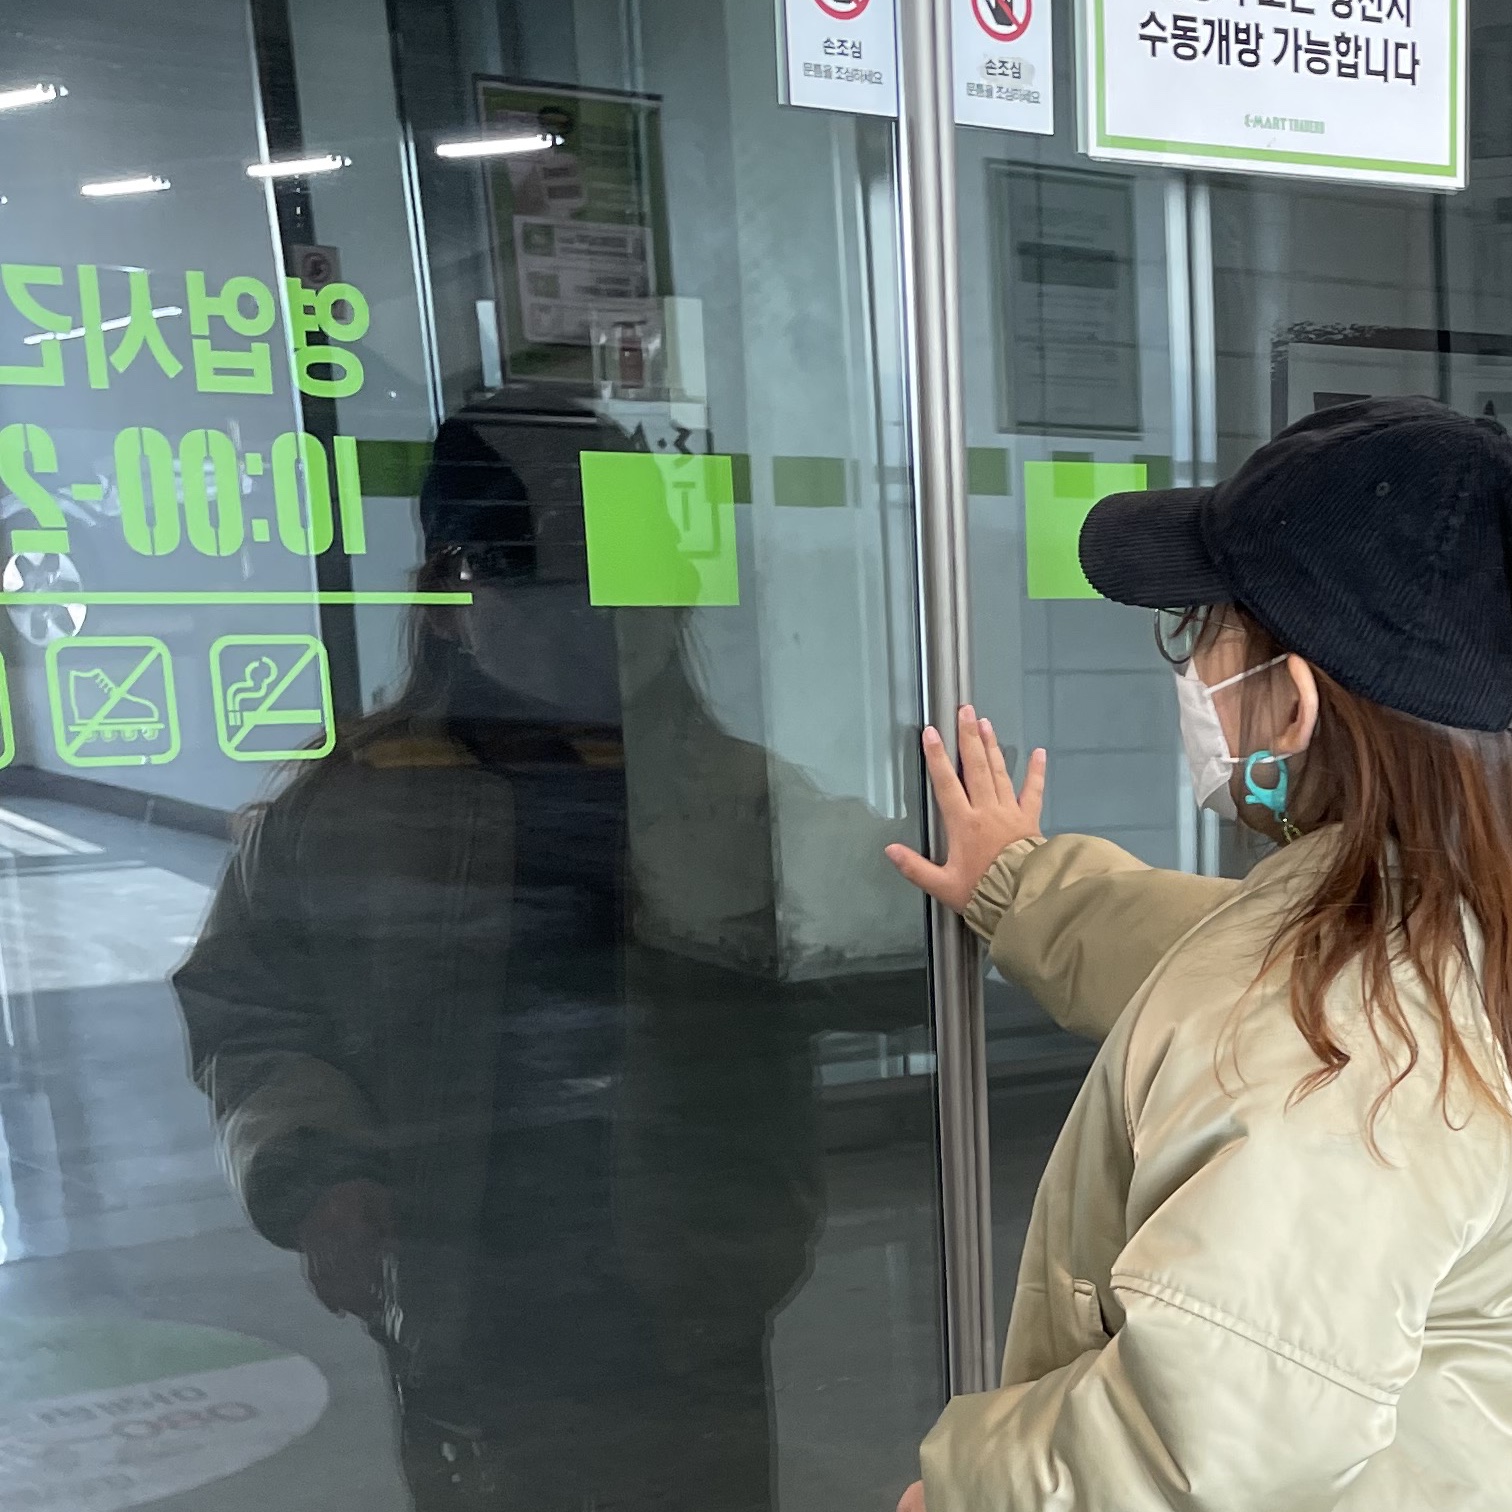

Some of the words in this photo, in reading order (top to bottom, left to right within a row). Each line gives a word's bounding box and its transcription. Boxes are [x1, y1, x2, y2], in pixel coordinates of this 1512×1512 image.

[823, 37, 863, 59] 손조심
[1138, 11, 1265, 67] 수동개방
[1272, 27, 1421, 86] 가능합니다
[834, 66, 883, 85] 조심하세요
[985, 58, 1022, 79] 손조심
